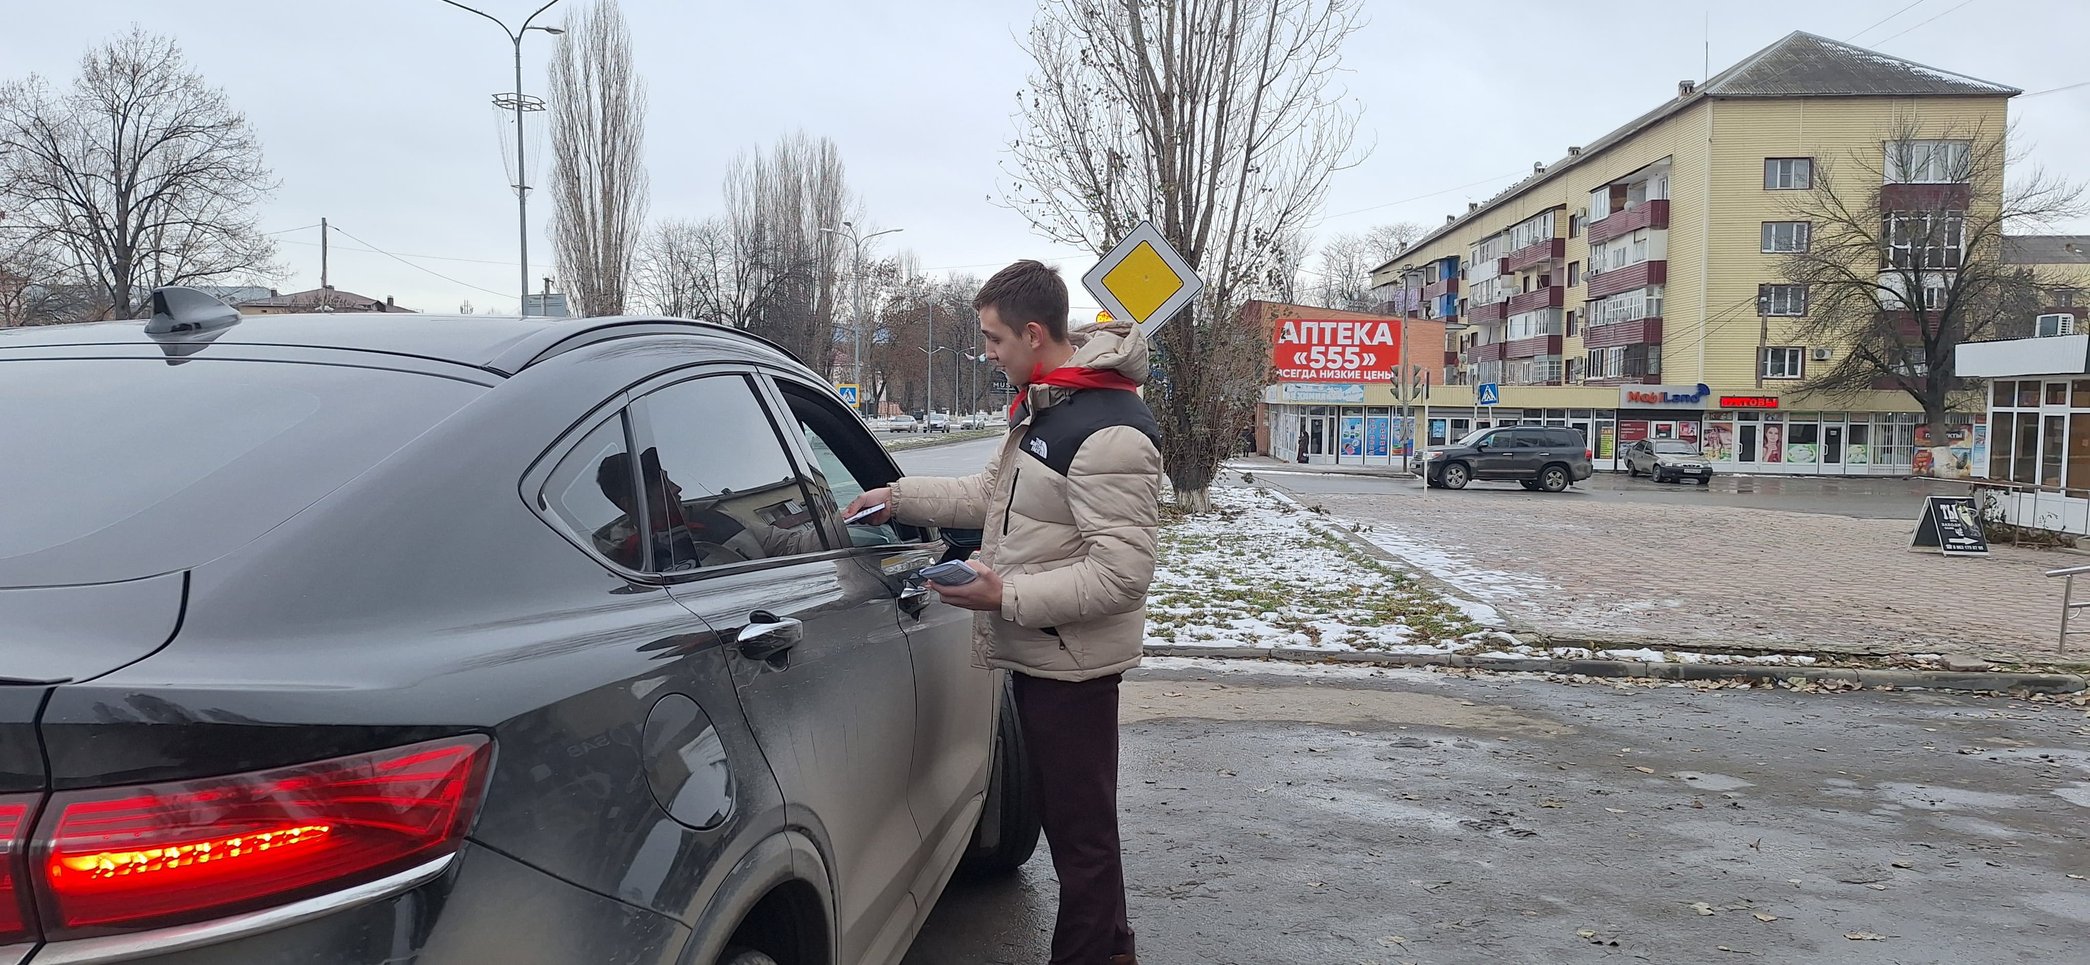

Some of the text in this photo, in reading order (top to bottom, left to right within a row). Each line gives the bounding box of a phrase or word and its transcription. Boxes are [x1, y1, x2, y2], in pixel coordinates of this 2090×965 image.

[1278, 321, 1393, 345] АПТЕКА
[1293, 346, 1376, 370] «555»
[1320, 370, 1360, 379] НИЗКИЕ
[1940, 504, 1959, 520] ТЫ
